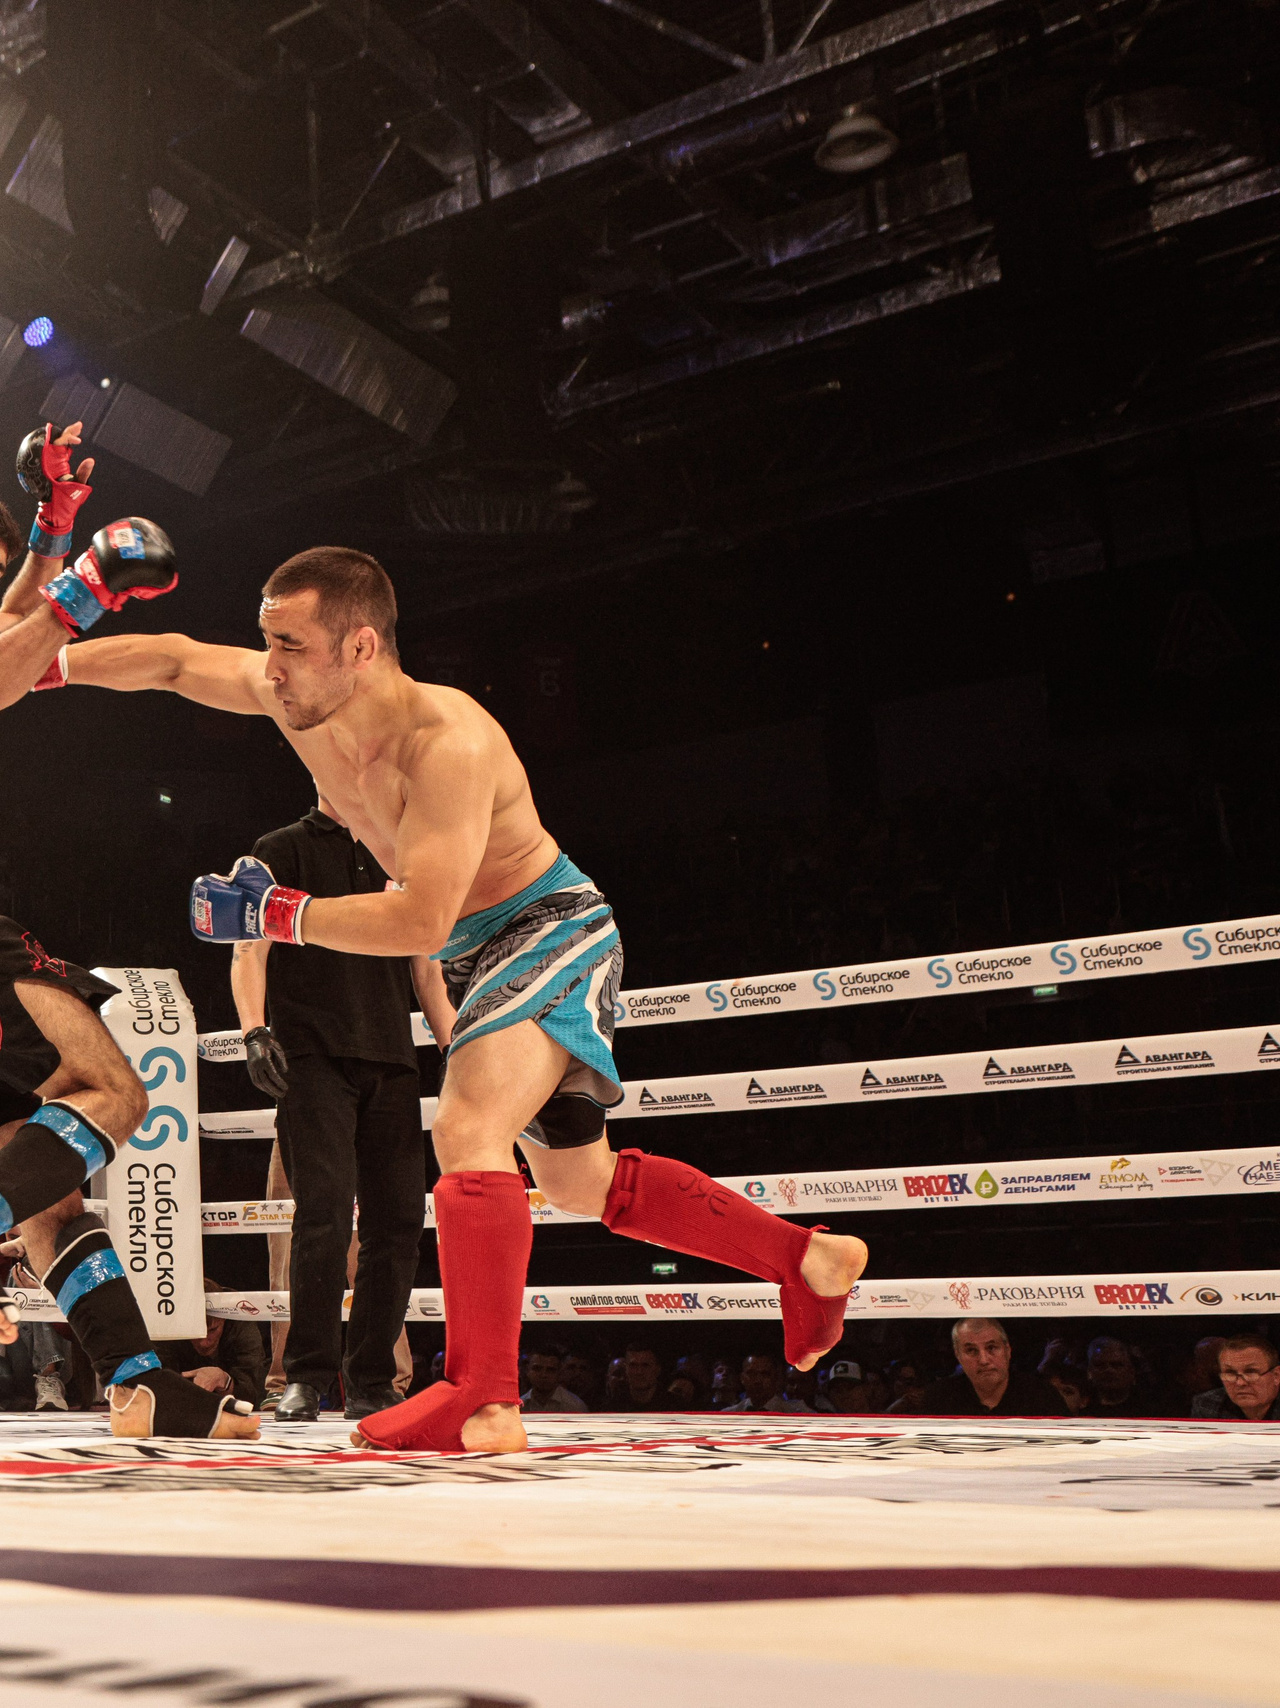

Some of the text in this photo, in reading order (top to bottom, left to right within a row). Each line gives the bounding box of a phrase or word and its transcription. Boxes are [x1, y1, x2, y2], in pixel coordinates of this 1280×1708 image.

[1215, 926, 1280, 943] Сибирск
[1080, 939, 1163, 959] Сибирское
[1218, 939, 1280, 956] Стекло
[955, 955, 1032, 974] Сибирское
[1083, 954, 1143, 971] Стекло
[839, 968, 910, 987] Сибирское
[958, 969, 1013, 984] Стекло
[730, 981, 796, 998] Сибирское
[842, 983, 893, 997] Стекло
[124, 970, 154, 1036] Сибирское
[154, 980, 180, 1036] Стекло
[628, 992, 690, 1009] Сибирское
[733, 995, 781, 1009] Стекло
[631, 1005, 675, 1019] Стекло
[203, 1037, 244, 1048] Сибирско
[1145, 1051, 1212, 1062] АВАНГАРД
[1010, 1063, 1073, 1074] АВАНГАРД
[885, 1073, 944, 1084] АВАНГАРД
[661, 1092, 712, 1102] АВАНГАРД
[770, 1084, 824, 1094] АВАНГАРД
[903, 1173, 973, 1198] BROZEX
[1001, 1172, 1091, 1185] ЗАПРАВЛЯЕМ
[803, 1179, 898, 1196] РАКОВАРНЯ
[1004, 1184, 1075, 1194] ДЕНЬГАМИ
[127, 1163, 150, 1273] Стекло
[151, 1163, 179, 1316] Сибирское
[570, 1295, 641, 1306] САМОЙЛОВ ФОНД
[645, 1293, 704, 1310] BROZEX
[978, 1286, 1085, 1301] РАКОВАРНЯ
[1094, 1283, 1173, 1305] BROZEX
